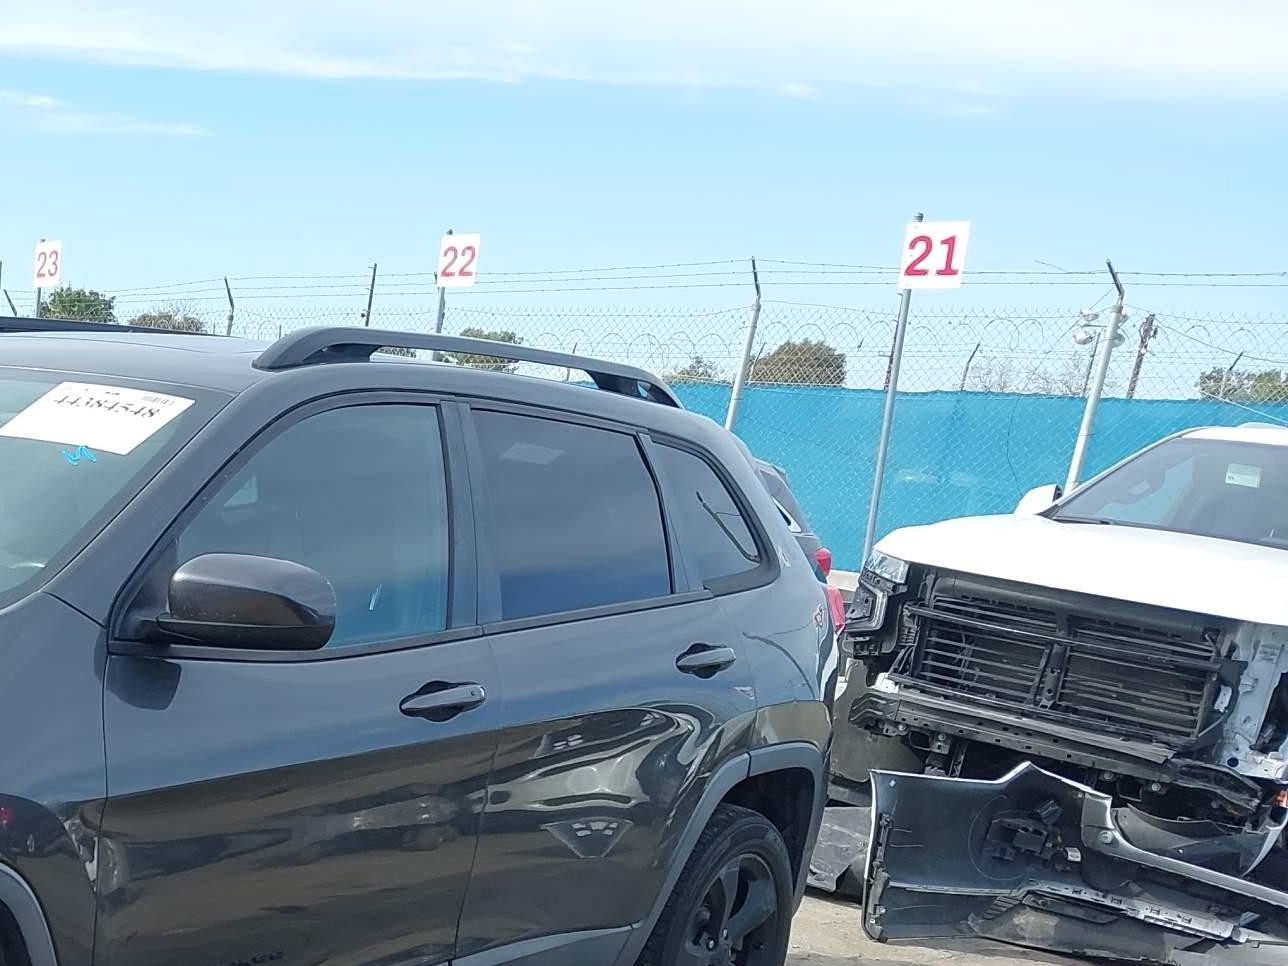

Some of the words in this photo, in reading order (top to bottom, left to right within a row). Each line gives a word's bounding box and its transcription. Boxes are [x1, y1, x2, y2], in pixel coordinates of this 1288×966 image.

[36, 249, 59, 278] 23
[440, 245, 476, 278] 22
[904, 235, 959, 276] 21
[52, 394, 161, 418] 44384548
